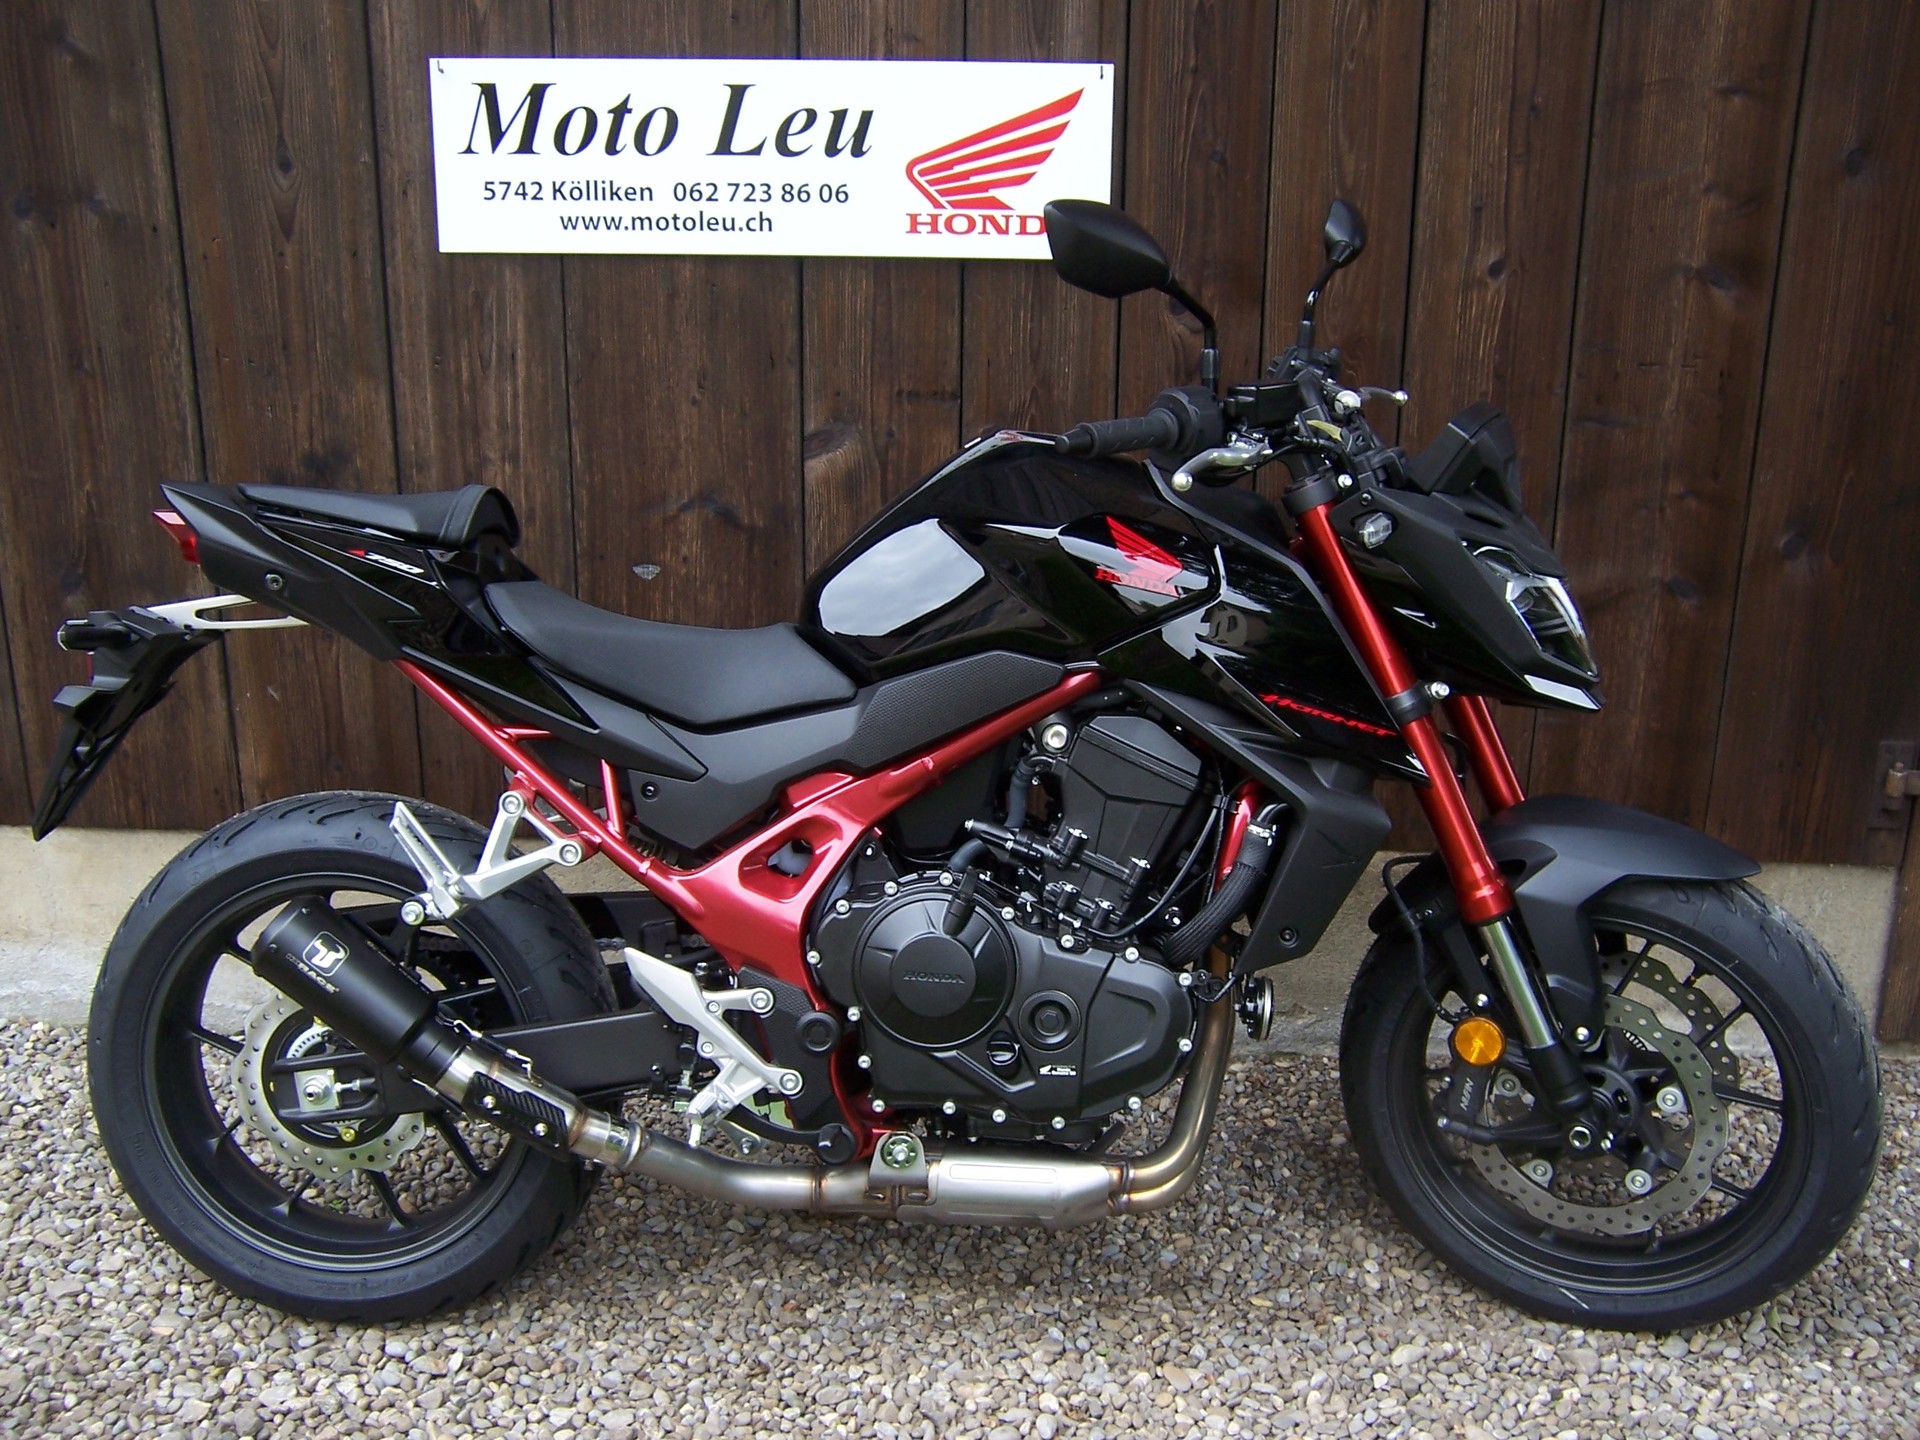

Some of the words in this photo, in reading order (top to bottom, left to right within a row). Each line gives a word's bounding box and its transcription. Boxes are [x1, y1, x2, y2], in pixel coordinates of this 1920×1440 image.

[458, 82, 679, 157] Moto
[706, 83, 874, 158] Leu
[483, 181, 544, 201] 5742
[552, 179, 654, 202] Kölliken
[673, 182, 719, 202] 062
[727, 182, 772, 203] 723
[781, 182, 811, 203] 86
[818, 183, 849, 204] 06
[559, 210, 773, 232] www.motoleu.ch
[906, 213, 1048, 236] HOND
[902, 970, 966, 985] HONDA
